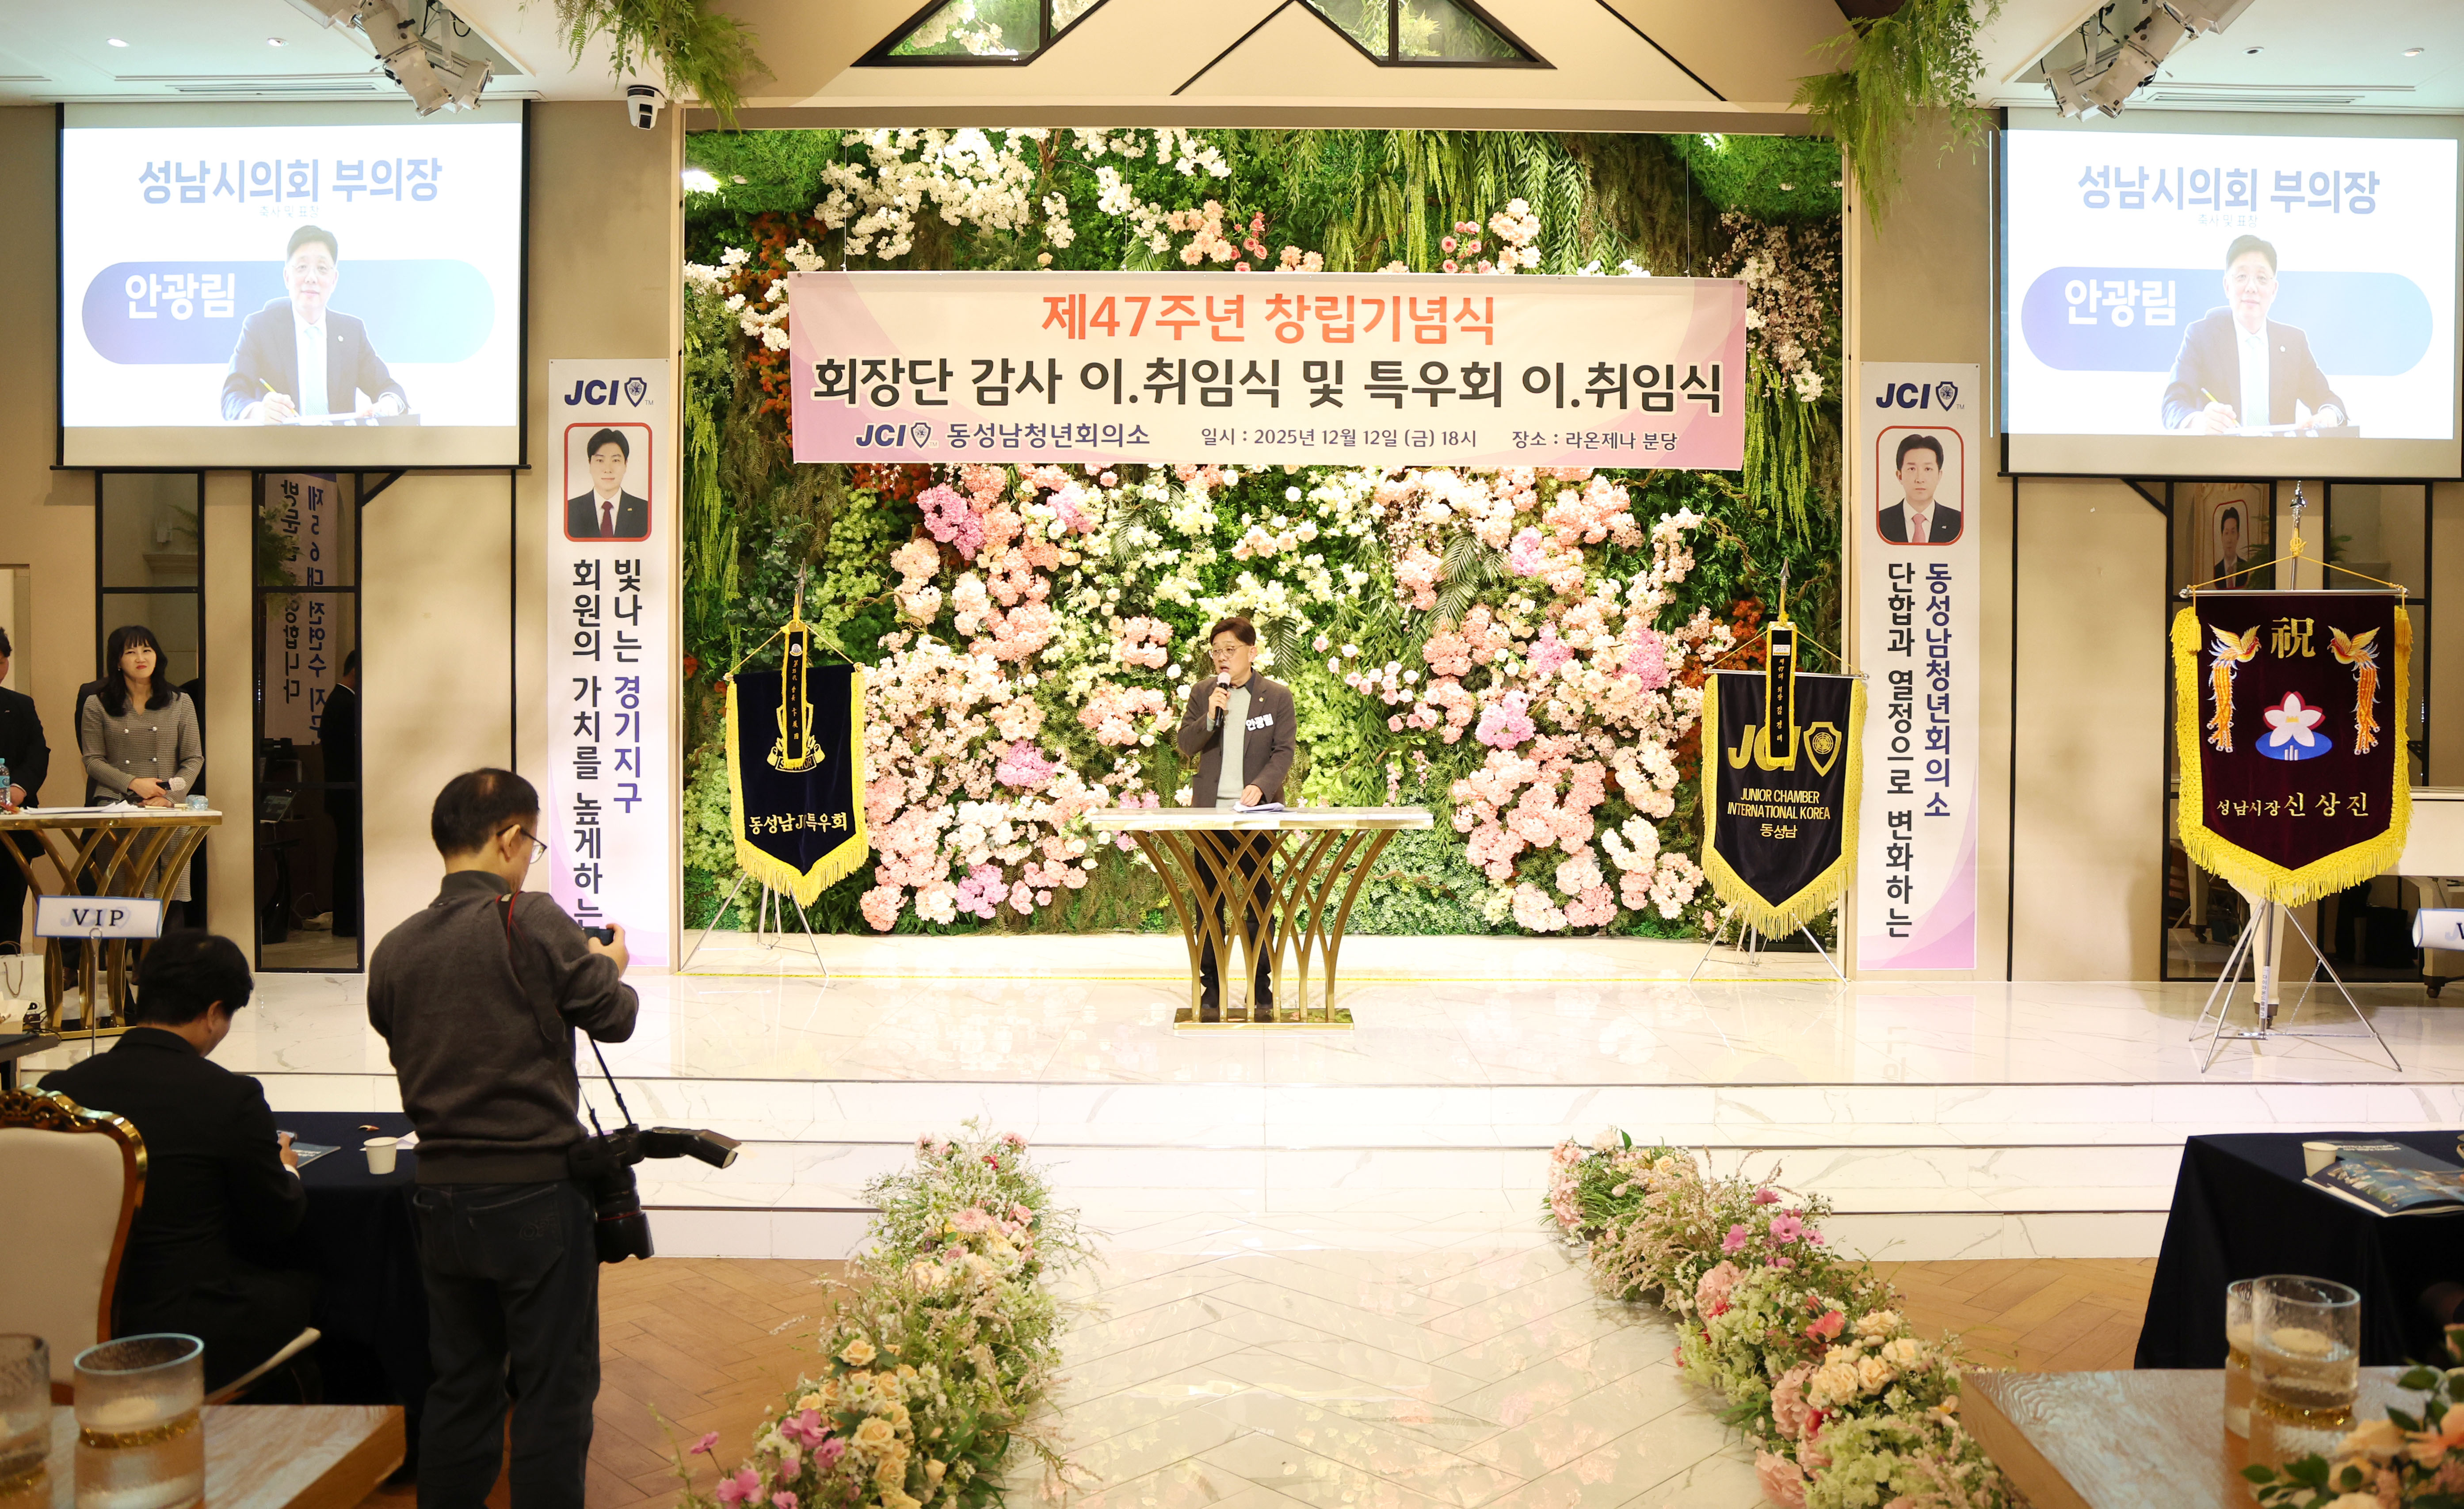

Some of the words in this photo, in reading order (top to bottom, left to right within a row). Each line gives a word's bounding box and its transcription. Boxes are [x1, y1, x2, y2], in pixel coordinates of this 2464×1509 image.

[139, 159, 319, 204] 성남시의회
[332, 158, 442, 202] 부의장
[2078, 165, 2257, 212] 성남시의회
[2270, 170, 2380, 214] 부의장
[259, 205, 281, 218] 축사
[284, 205, 294, 218] 및
[298, 205, 319, 218] 표창
[2198, 213, 2219, 227] 축사
[2223, 214, 2232, 227] 및
[2237, 214, 2258, 228] 표창
[125, 273, 235, 320] 안광림
[2065, 279, 2176, 328] 안광림
[1042, 293, 1245, 342] 제47주년
[1265, 293, 1494, 346] 창립기념식
[564, 380, 619, 405] JCI
[814, 358, 954, 408] 회장단
[971, 358, 1063, 406] 감사
[1080, 357, 1279, 409] 이.취임식
[1303, 360, 1343, 408] 및
[1364, 361, 1502, 409] 특우회
[1522, 361, 1720, 413] 이.취임식
[1876, 383, 1931, 409] JCI
[856, 424, 906, 446] JCI
[946, 422, 1150, 449] 동성남청년회의소
[1201, 427, 1235, 446] 일시
[1254, 429, 1315, 446] 2025년
[1322, 429, 1356, 447] 12월
[1363, 429, 1397, 447] 12일
[1404, 429, 1435, 448] (금)
[1442, 430, 1476, 448] 18시
[1512, 431, 1547, 449] 장소
[1565, 431, 1637, 450] 라온제나
[1642, 432, 1678, 451] 분당
[572, 559, 601, 662] 회원의
[613, 559, 643, 663] 빛나는
[1887, 562, 1915, 657] 단합과
[2271, 617, 2316, 659] 祝
[1924, 563, 1952, 817] 동성남청년회의소
[572, 675, 602, 780] 가치를
[613, 676, 643, 813] 경기지구
[1245, 713, 1274, 732] 안광림
[1887, 670, 1914, 794] 열정으로
[1727, 801, 1798, 819] INTERNATIONAL
[1800, 806, 1831, 820] KOREA
[1740, 788, 1772, 803] JUNIOR
[1774, 789, 1820, 804] CHAMBER
[2216, 799, 2281, 817] 성남시장
[1759, 823, 1798, 839] 동성남
[573, 792, 603, 930] 높게하는
[1885, 810, 1914, 938] 변화하는
[72, 908, 124, 926] VIP
